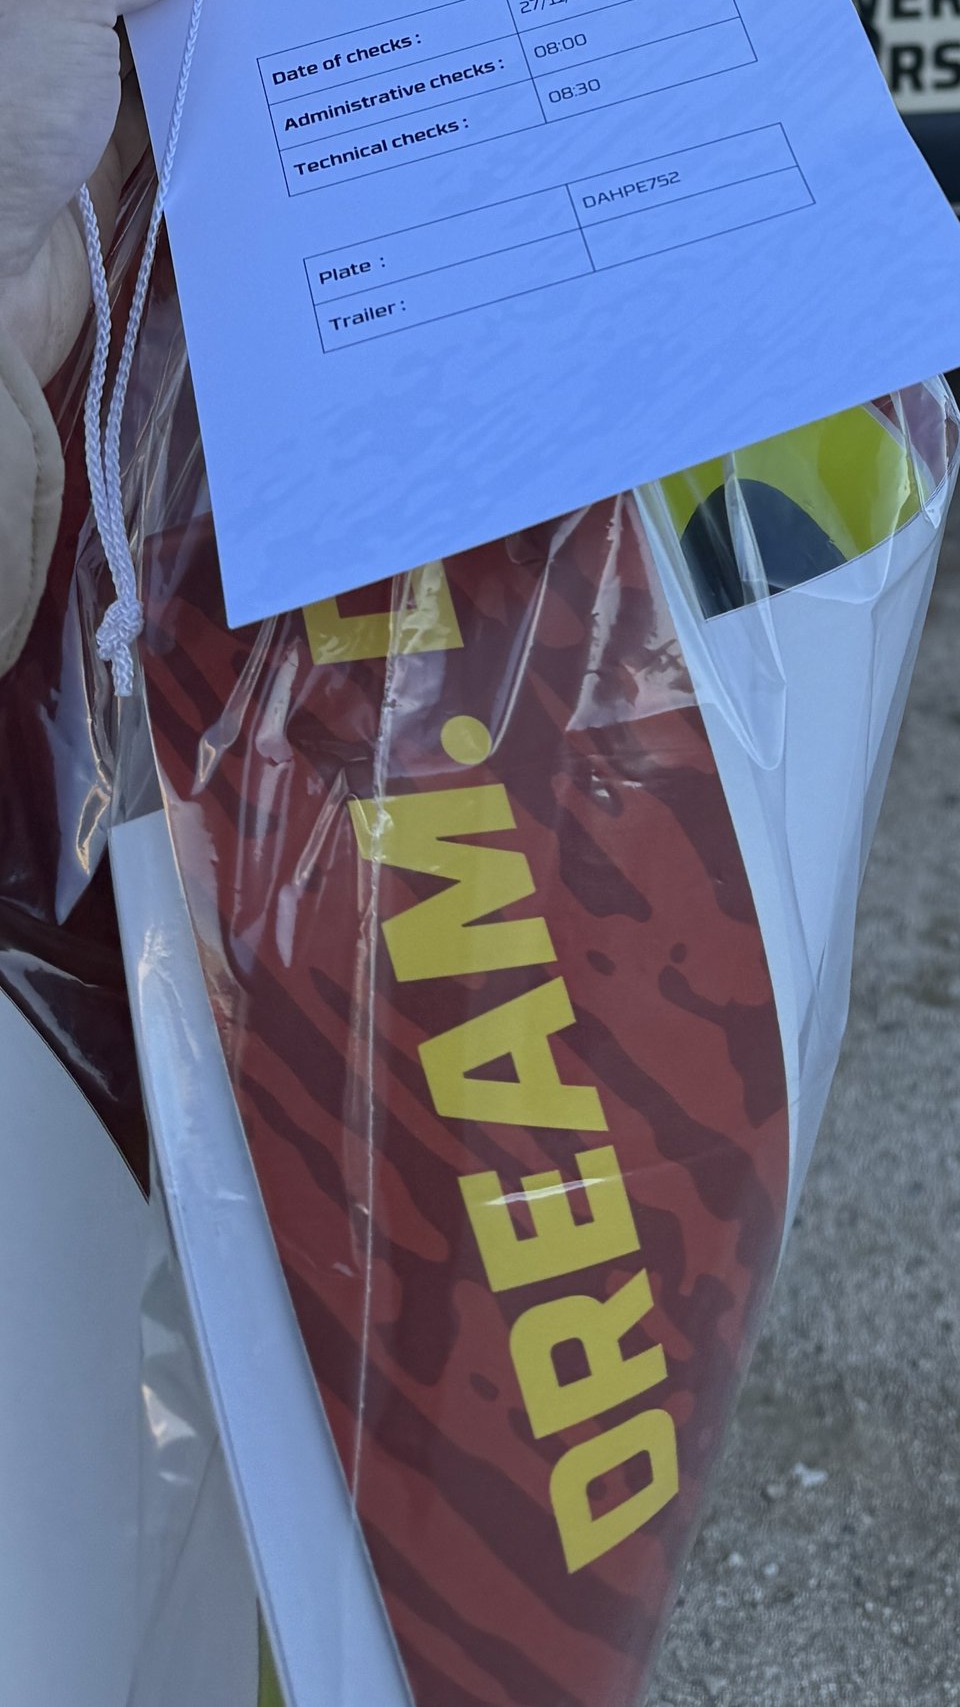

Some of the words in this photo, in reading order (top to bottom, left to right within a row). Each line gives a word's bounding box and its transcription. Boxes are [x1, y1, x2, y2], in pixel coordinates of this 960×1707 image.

[272, 64, 318, 85] Date
[322, 54, 342, 70] of
[346, 35, 412, 63] checks
[534, 33, 588, 59] 08:00
[284, 82, 426, 131] Administrative
[430, 60, 496, 88] checks
[548, 79, 601, 104] 08:30
[293, 139, 388, 175] Technical
[391, 120, 459, 148] checks
[582, 171, 681, 209] DAHPE752
[319, 261, 371, 285] Plate
[328, 303, 396, 331] Trailer
[347, 715, 680, 1575] DREAM.
